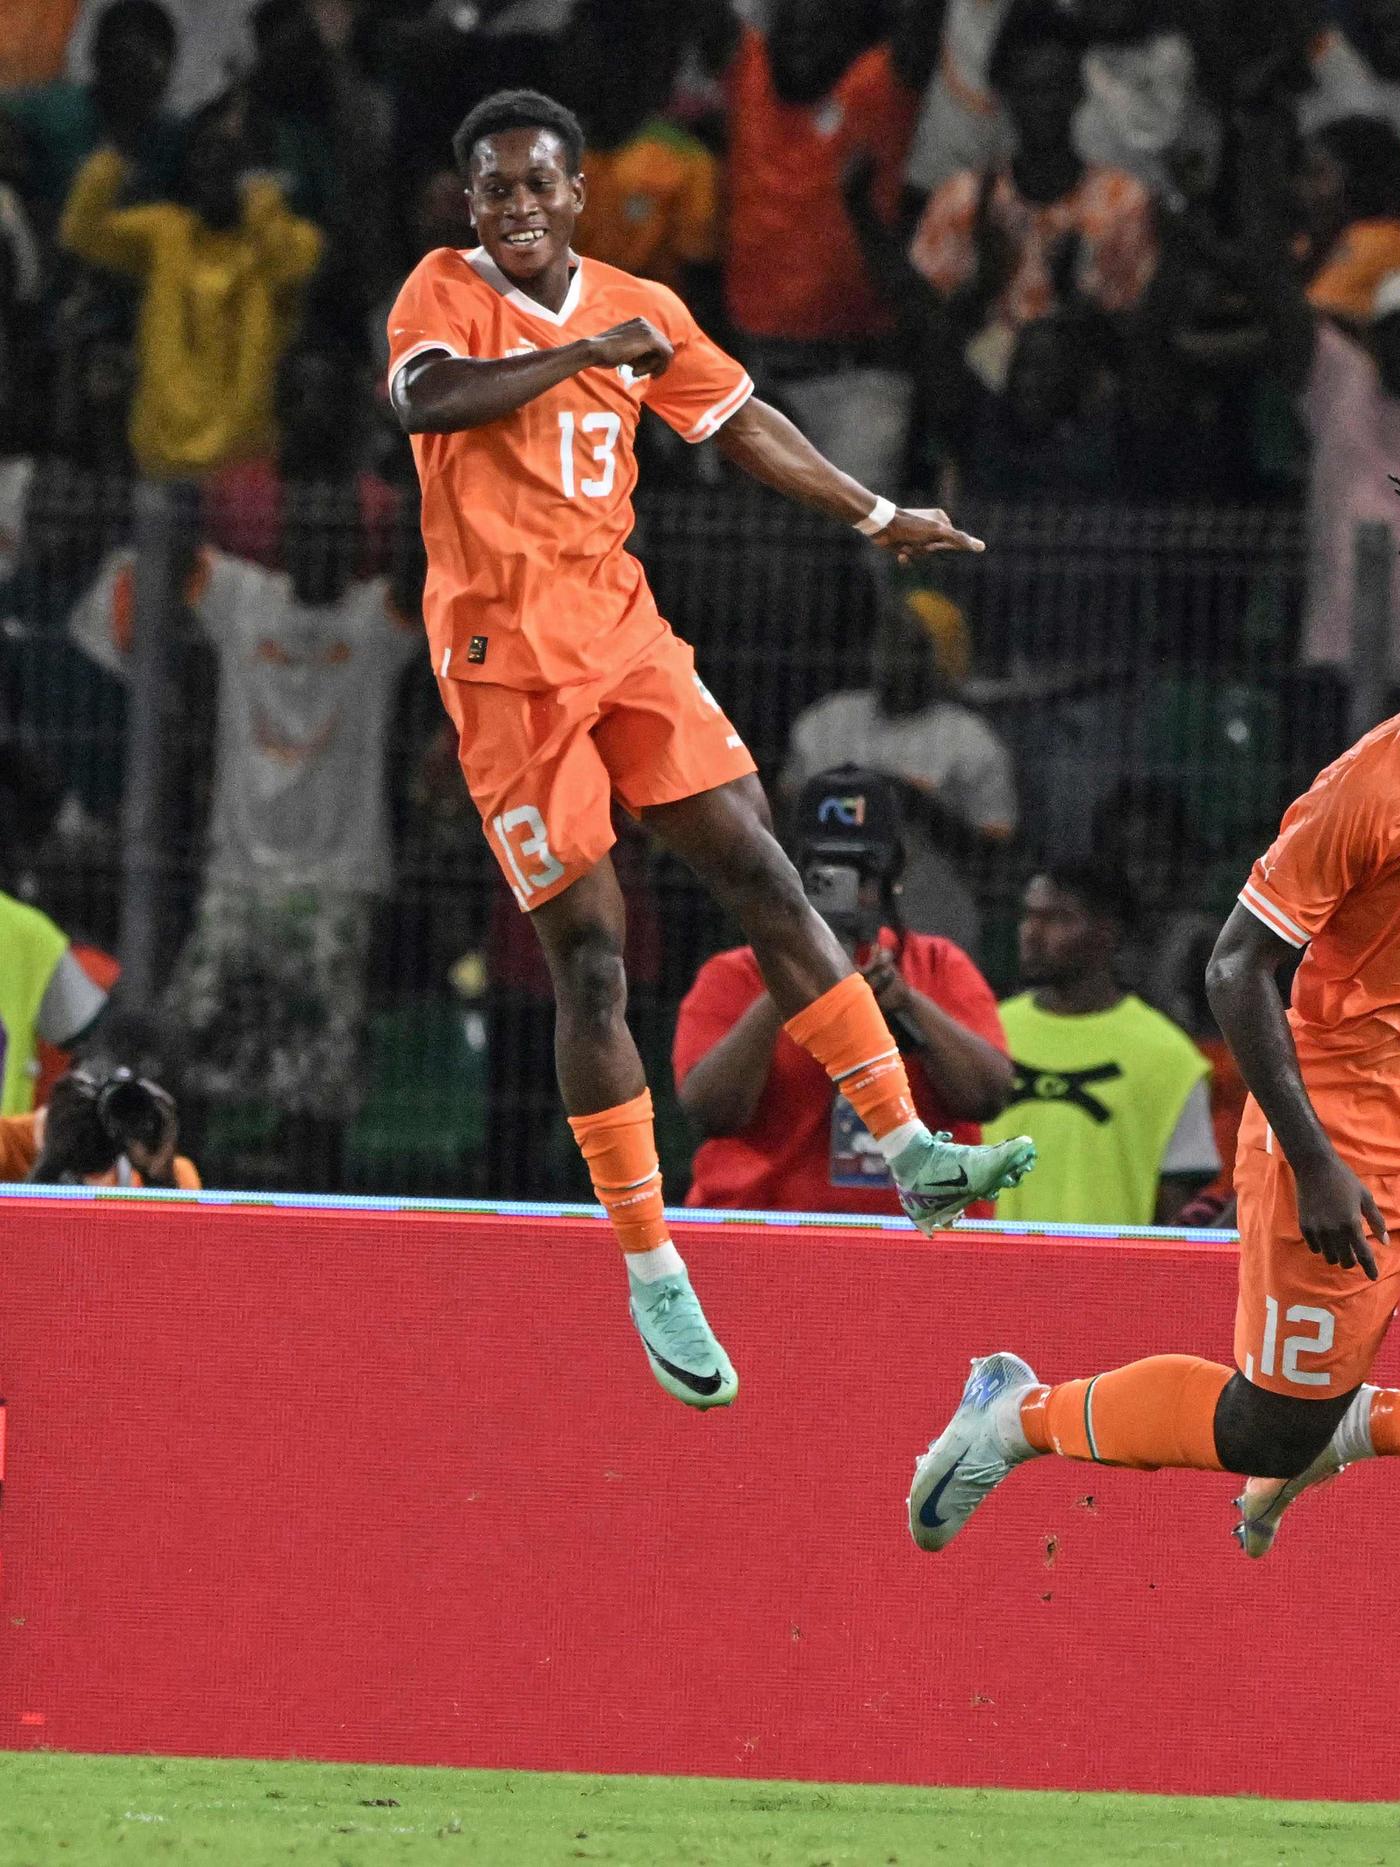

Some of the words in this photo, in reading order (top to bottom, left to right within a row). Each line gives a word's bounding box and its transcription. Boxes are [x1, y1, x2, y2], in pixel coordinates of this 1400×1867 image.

[558, 411, 621, 498] 13
[493, 805, 565, 896] 13
[1261, 1295, 1335, 1386] 12
